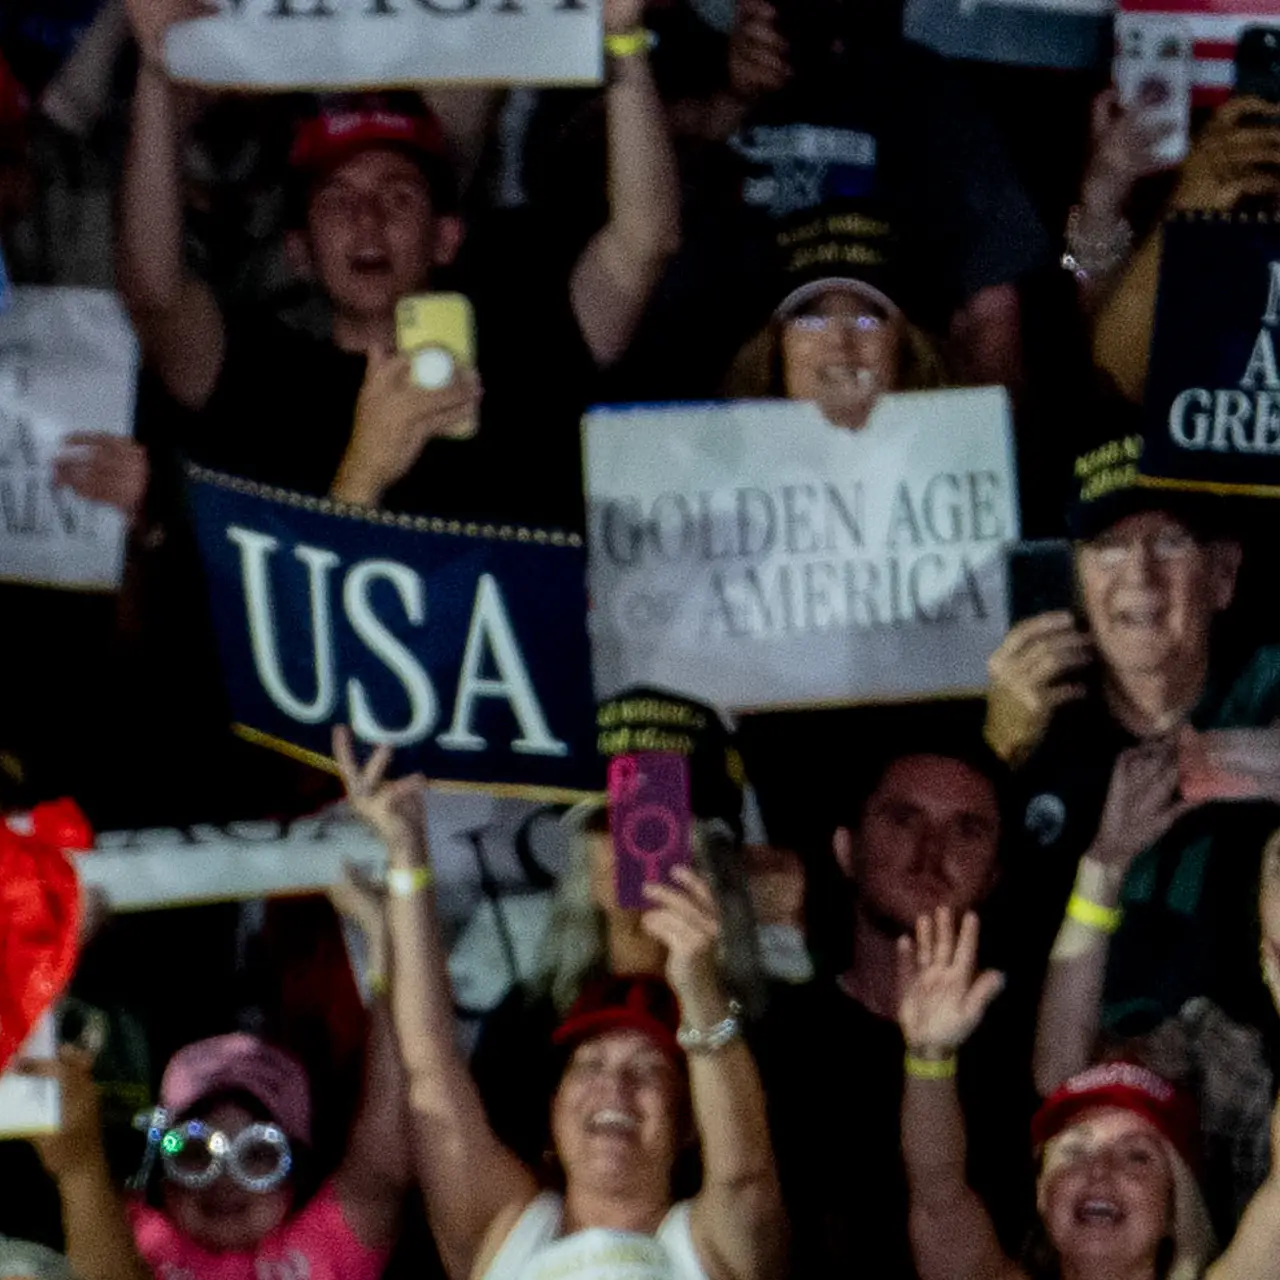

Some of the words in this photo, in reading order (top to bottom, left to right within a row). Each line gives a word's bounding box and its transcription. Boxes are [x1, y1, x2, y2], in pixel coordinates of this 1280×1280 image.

[598, 481, 868, 569] GOLDEN
[885, 469, 1005, 551] AGE
[225, 525, 568, 757] USA
[701, 552, 991, 638] AMERICA
